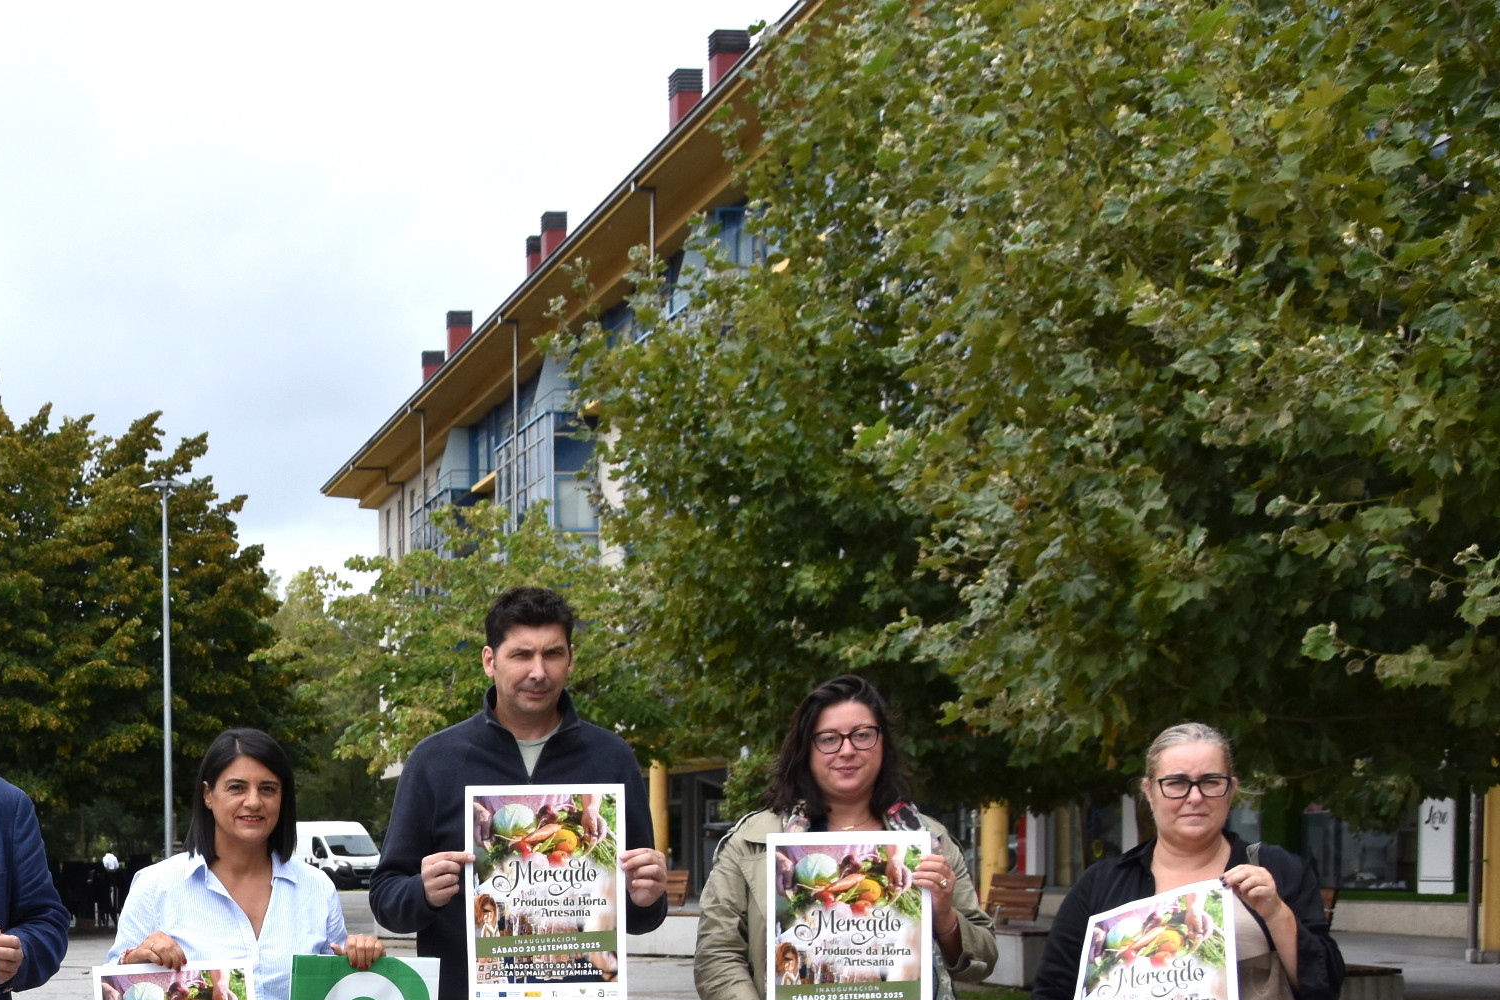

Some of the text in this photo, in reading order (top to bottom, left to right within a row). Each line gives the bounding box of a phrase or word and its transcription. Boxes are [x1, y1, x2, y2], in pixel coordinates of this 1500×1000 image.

[492, 859, 597, 897] Mercado
[513, 896, 607, 907] Produtos da Horta
[794, 909, 901, 946] Mercado
[515, 936, 577, 945] INAUGURACIÓN
[491, 945, 524, 955] SÁBADO
[538, 943, 579, 951] SETEMBRO
[814, 946, 911, 956] Produtos da Horta
[500, 962, 534, 970] SÁBADOS
[552, 967, 603, 976] BERTAMIRÁNS
[839, 992, 882, 1000] SETEMBRO
